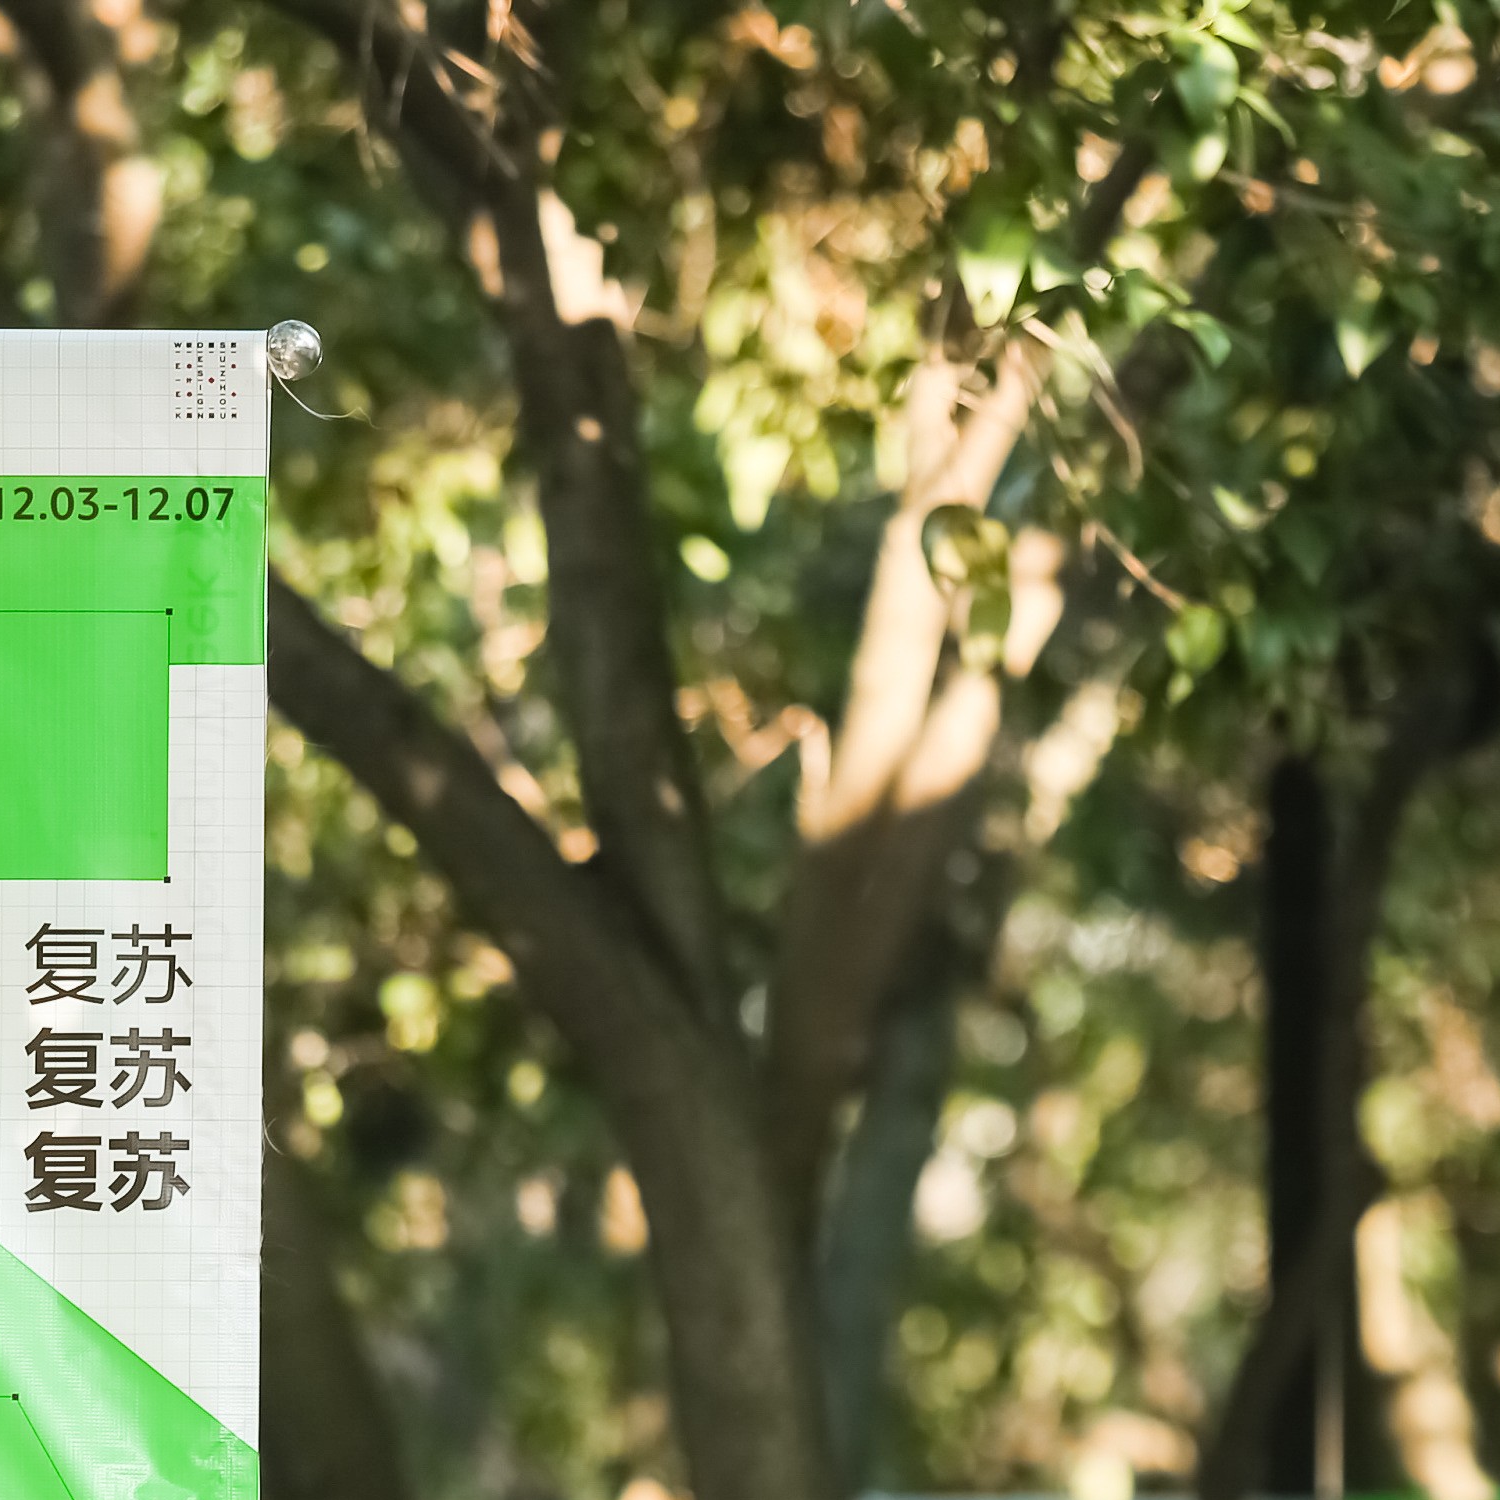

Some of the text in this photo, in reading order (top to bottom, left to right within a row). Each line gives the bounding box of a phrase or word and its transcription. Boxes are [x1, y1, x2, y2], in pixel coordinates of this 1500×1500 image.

[25, 923, 193, 1005] 复苏
[25, 1028, 192, 1109] 复苏
[24, 1131, 190, 1212] 复苏
